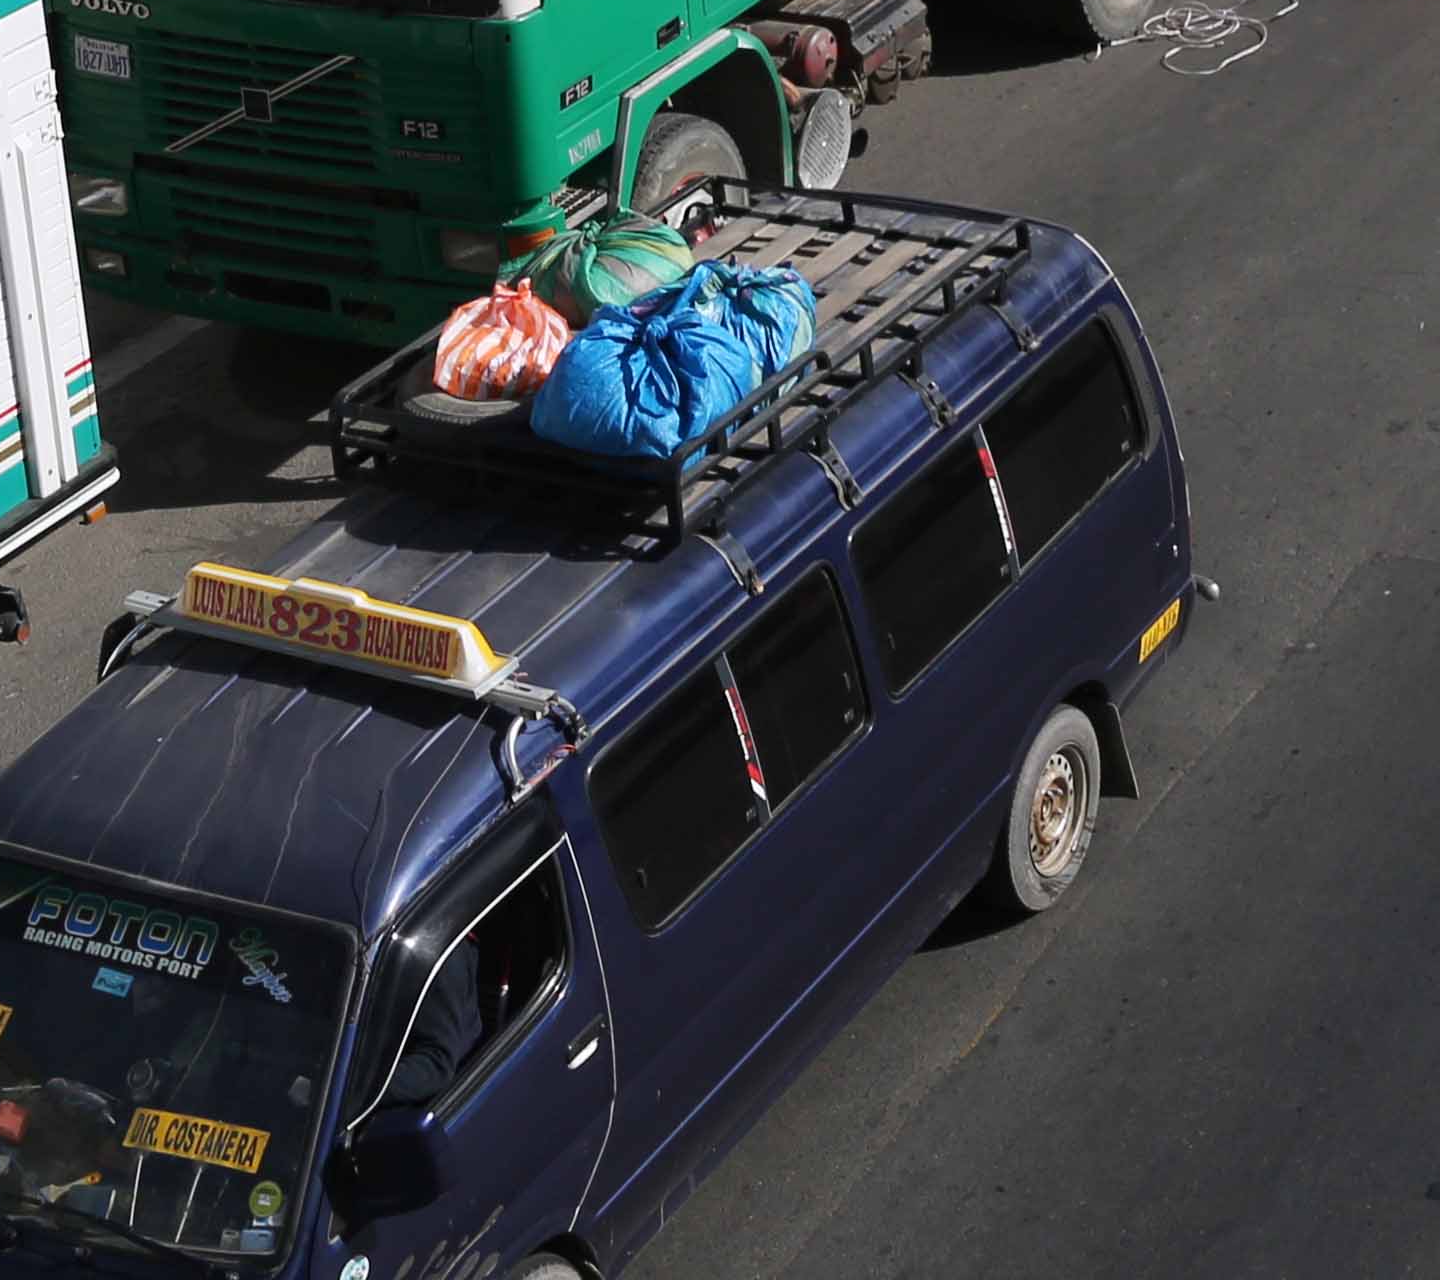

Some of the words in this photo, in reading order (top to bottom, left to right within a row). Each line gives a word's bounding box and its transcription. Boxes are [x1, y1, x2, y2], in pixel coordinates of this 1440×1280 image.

[565, 79, 590, 107] F12
[403, 120, 440, 138] F12
[192, 574, 224, 615] LUIS
[227, 585, 265, 627] LARA
[269, 595, 361, 651] 823
[363, 615, 451, 671] HUAYHUASI
[27, 886, 219, 965] FOTON
[23, 926, 84, 953] RACING
[85, 940, 154, 970] MOTORS
[155, 956, 205, 980] PORT
[128, 1113, 159, 1146] DIR.
[163, 1118, 259, 1168] COSTANERA
